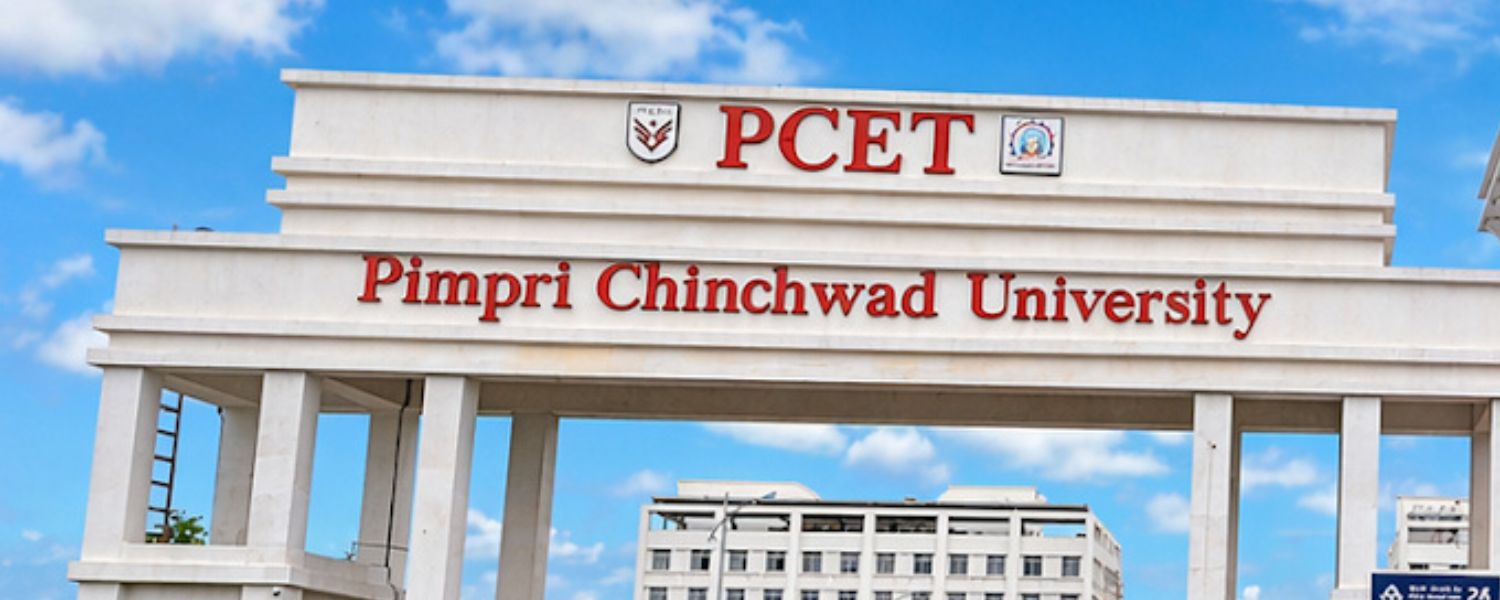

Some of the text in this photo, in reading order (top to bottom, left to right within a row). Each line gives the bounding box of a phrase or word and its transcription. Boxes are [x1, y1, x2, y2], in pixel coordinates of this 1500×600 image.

[717, 104, 974, 175] PCET
[358, 253, 1272, 339] Pimpri Chinchwad University
